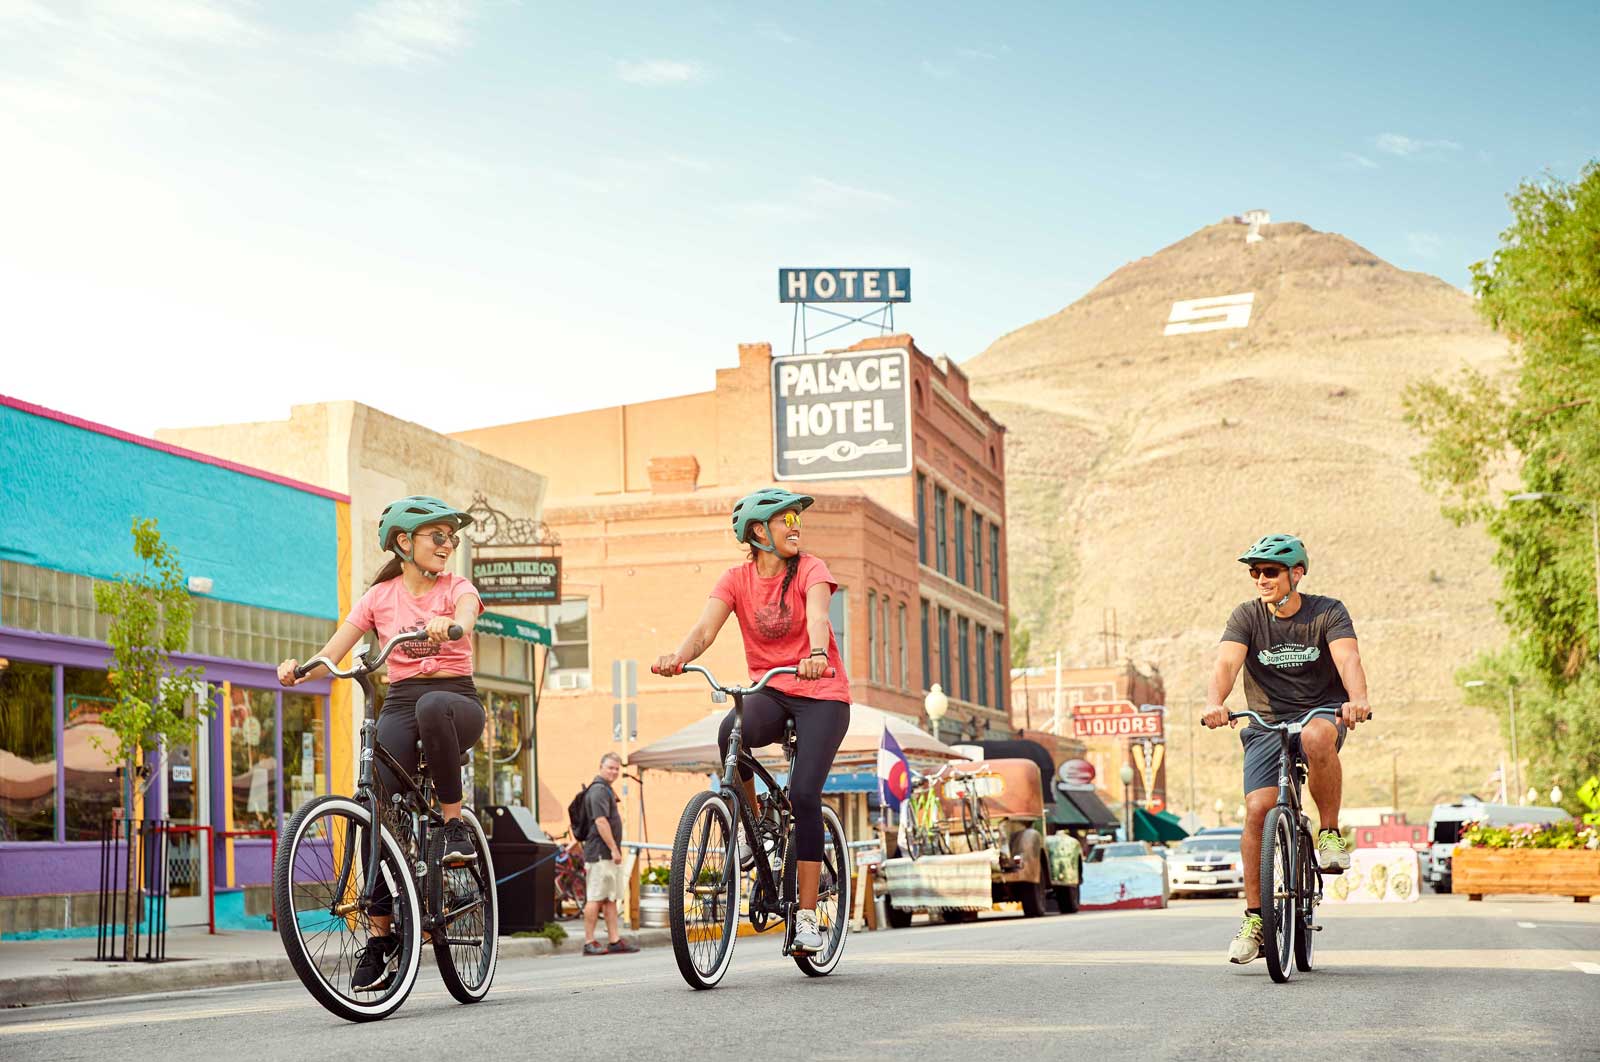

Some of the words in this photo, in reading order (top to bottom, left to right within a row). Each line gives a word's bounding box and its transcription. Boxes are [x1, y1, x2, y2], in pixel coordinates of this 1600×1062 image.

[788, 271, 906, 299] HOTEL
[1164, 292, 1256, 337] S
[779, 356, 902, 397] PALACE
[786, 399, 895, 438] HOTEL
[474, 562, 512, 578] SALIDA
[513, 561, 540, 575] BIKE
[1075, 717, 1157, 735] LIQUORS
